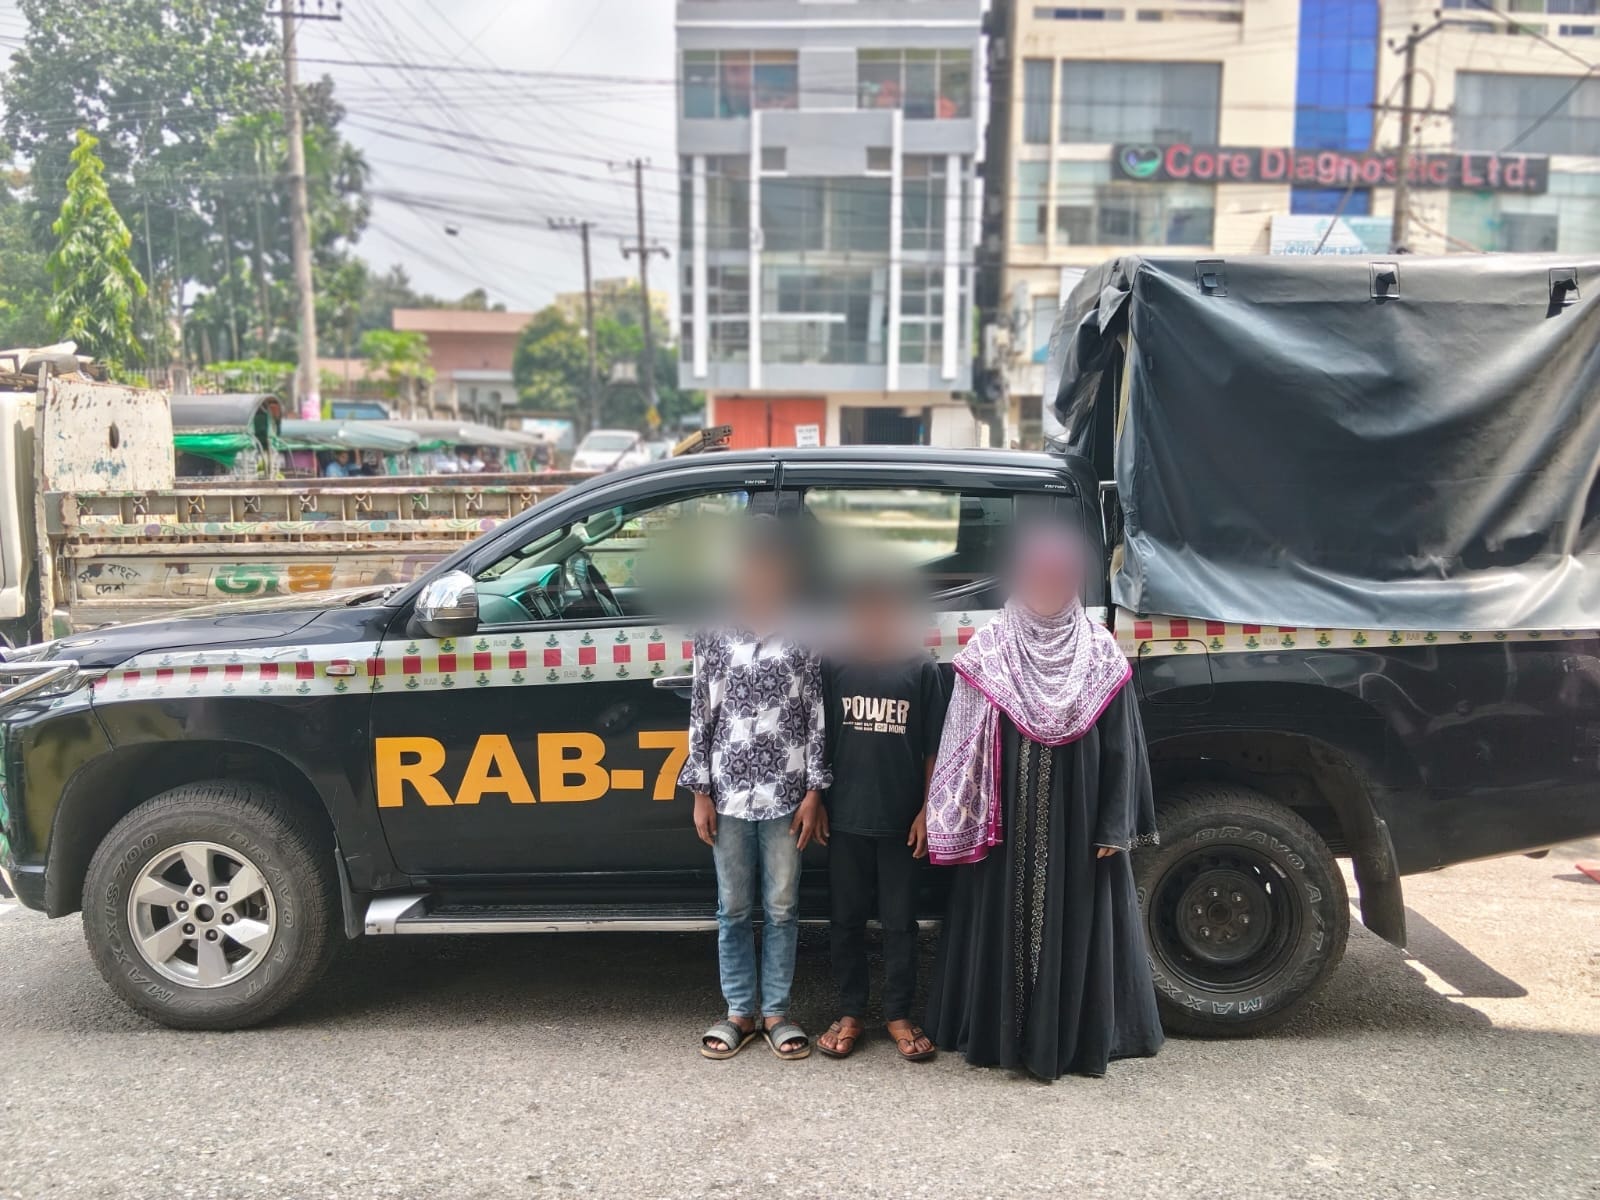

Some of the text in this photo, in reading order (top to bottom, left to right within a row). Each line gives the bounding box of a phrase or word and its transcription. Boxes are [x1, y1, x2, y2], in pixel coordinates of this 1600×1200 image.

[1165, 144, 1536, 187] Core Diagnostic Ltd.
[841, 696, 910, 724] POWER
[375, 730, 690, 808] RAB-7
[1194, 826, 1305, 869] BRAVO
[227, 832, 295, 928] BRAVO
[105, 882, 175, 1003] MAXXIS
